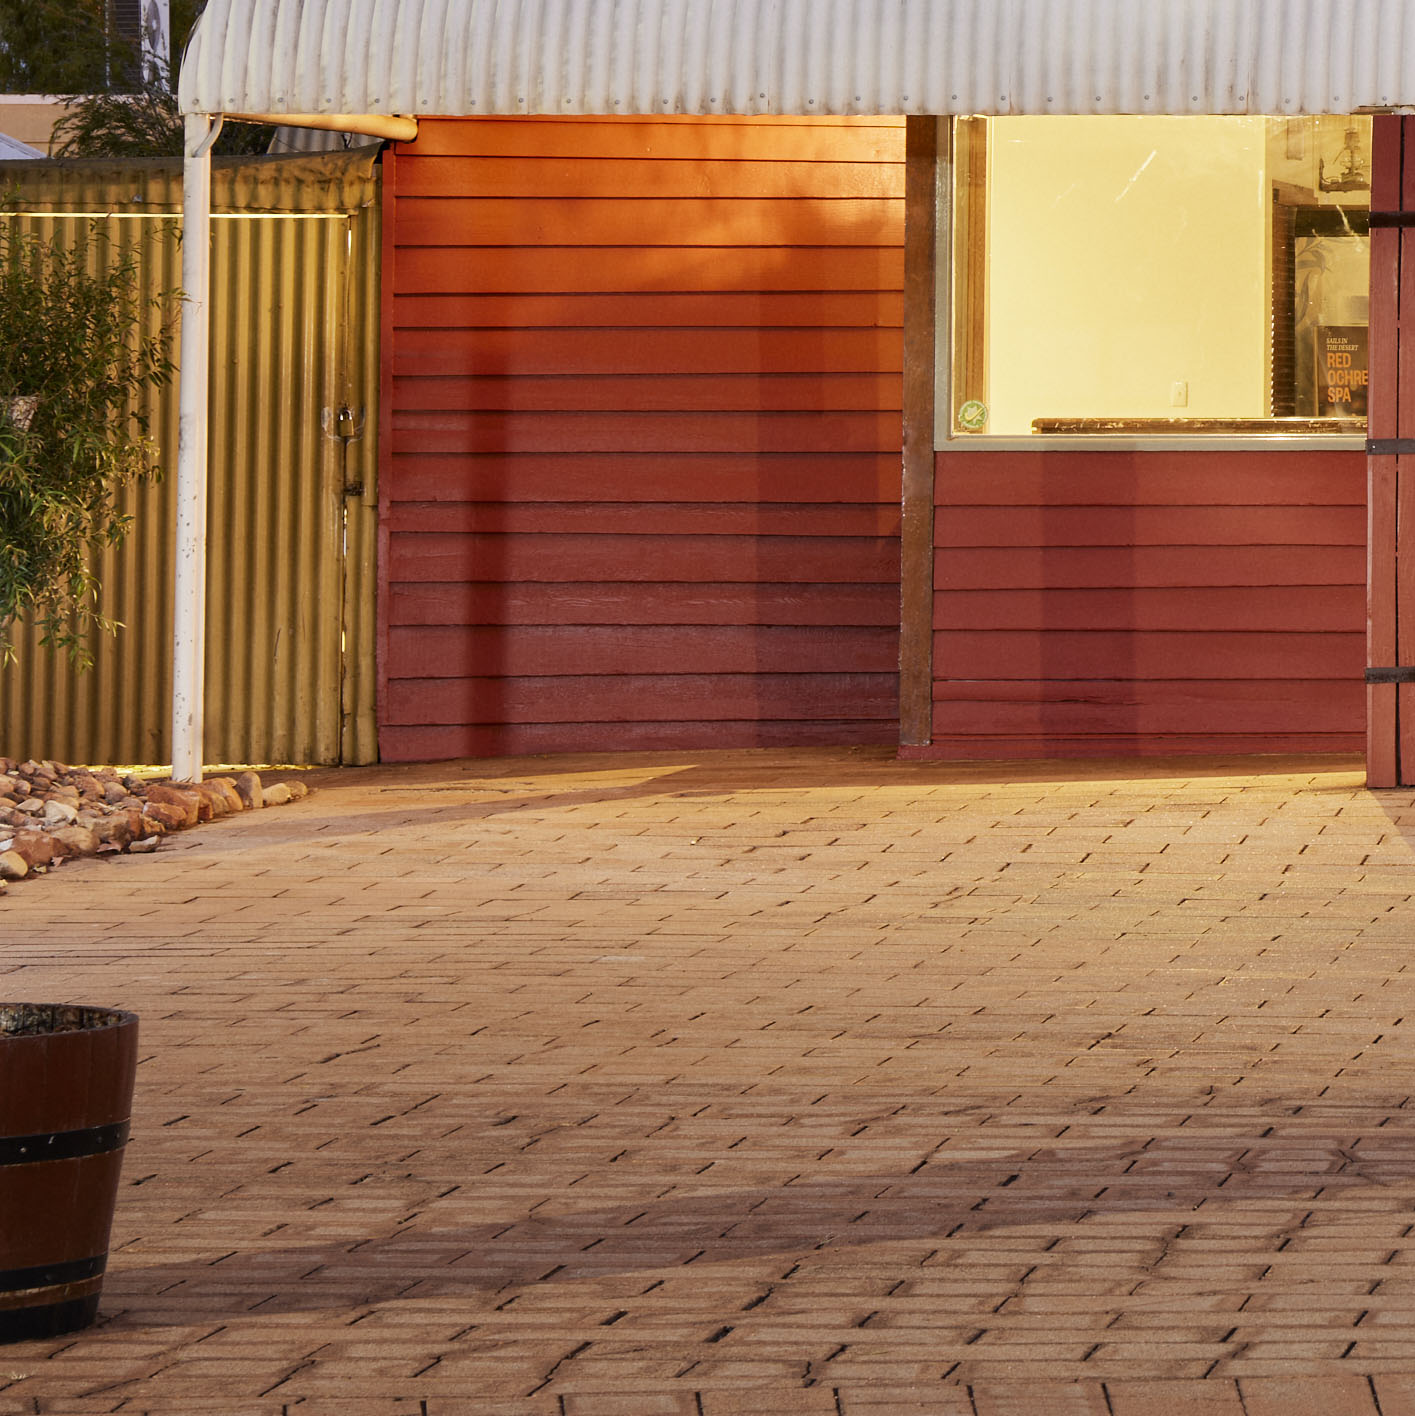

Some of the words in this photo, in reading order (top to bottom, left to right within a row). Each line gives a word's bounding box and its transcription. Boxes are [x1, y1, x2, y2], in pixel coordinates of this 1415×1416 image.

[1327, 352, 1352, 368] RED
[1327, 369, 1369, 386] OCHRE
[1327, 386, 1352, 403] SPA
